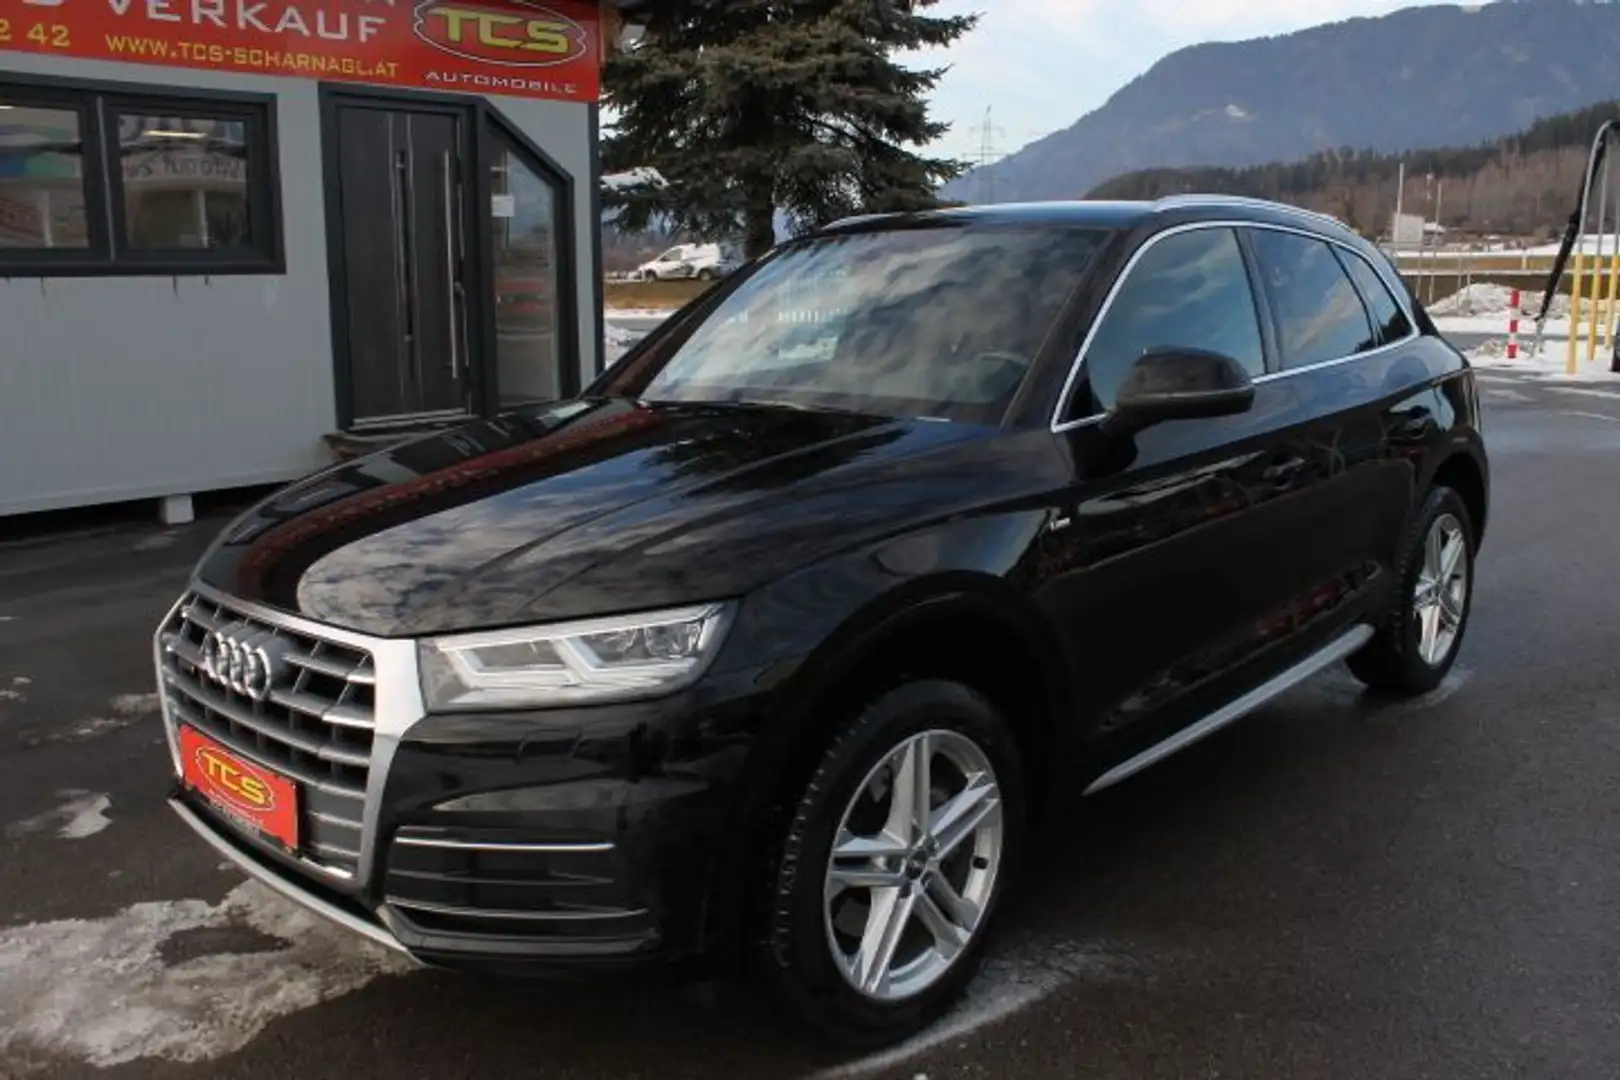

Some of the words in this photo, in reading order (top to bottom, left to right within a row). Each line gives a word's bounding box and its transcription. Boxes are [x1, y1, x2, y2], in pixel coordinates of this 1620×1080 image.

[27, 23, 71, 47] 42
[428, 6, 569, 54] TCS
[425, 71, 578, 94] AUTOMOBILE
[200, 751, 265, 805] TCS
